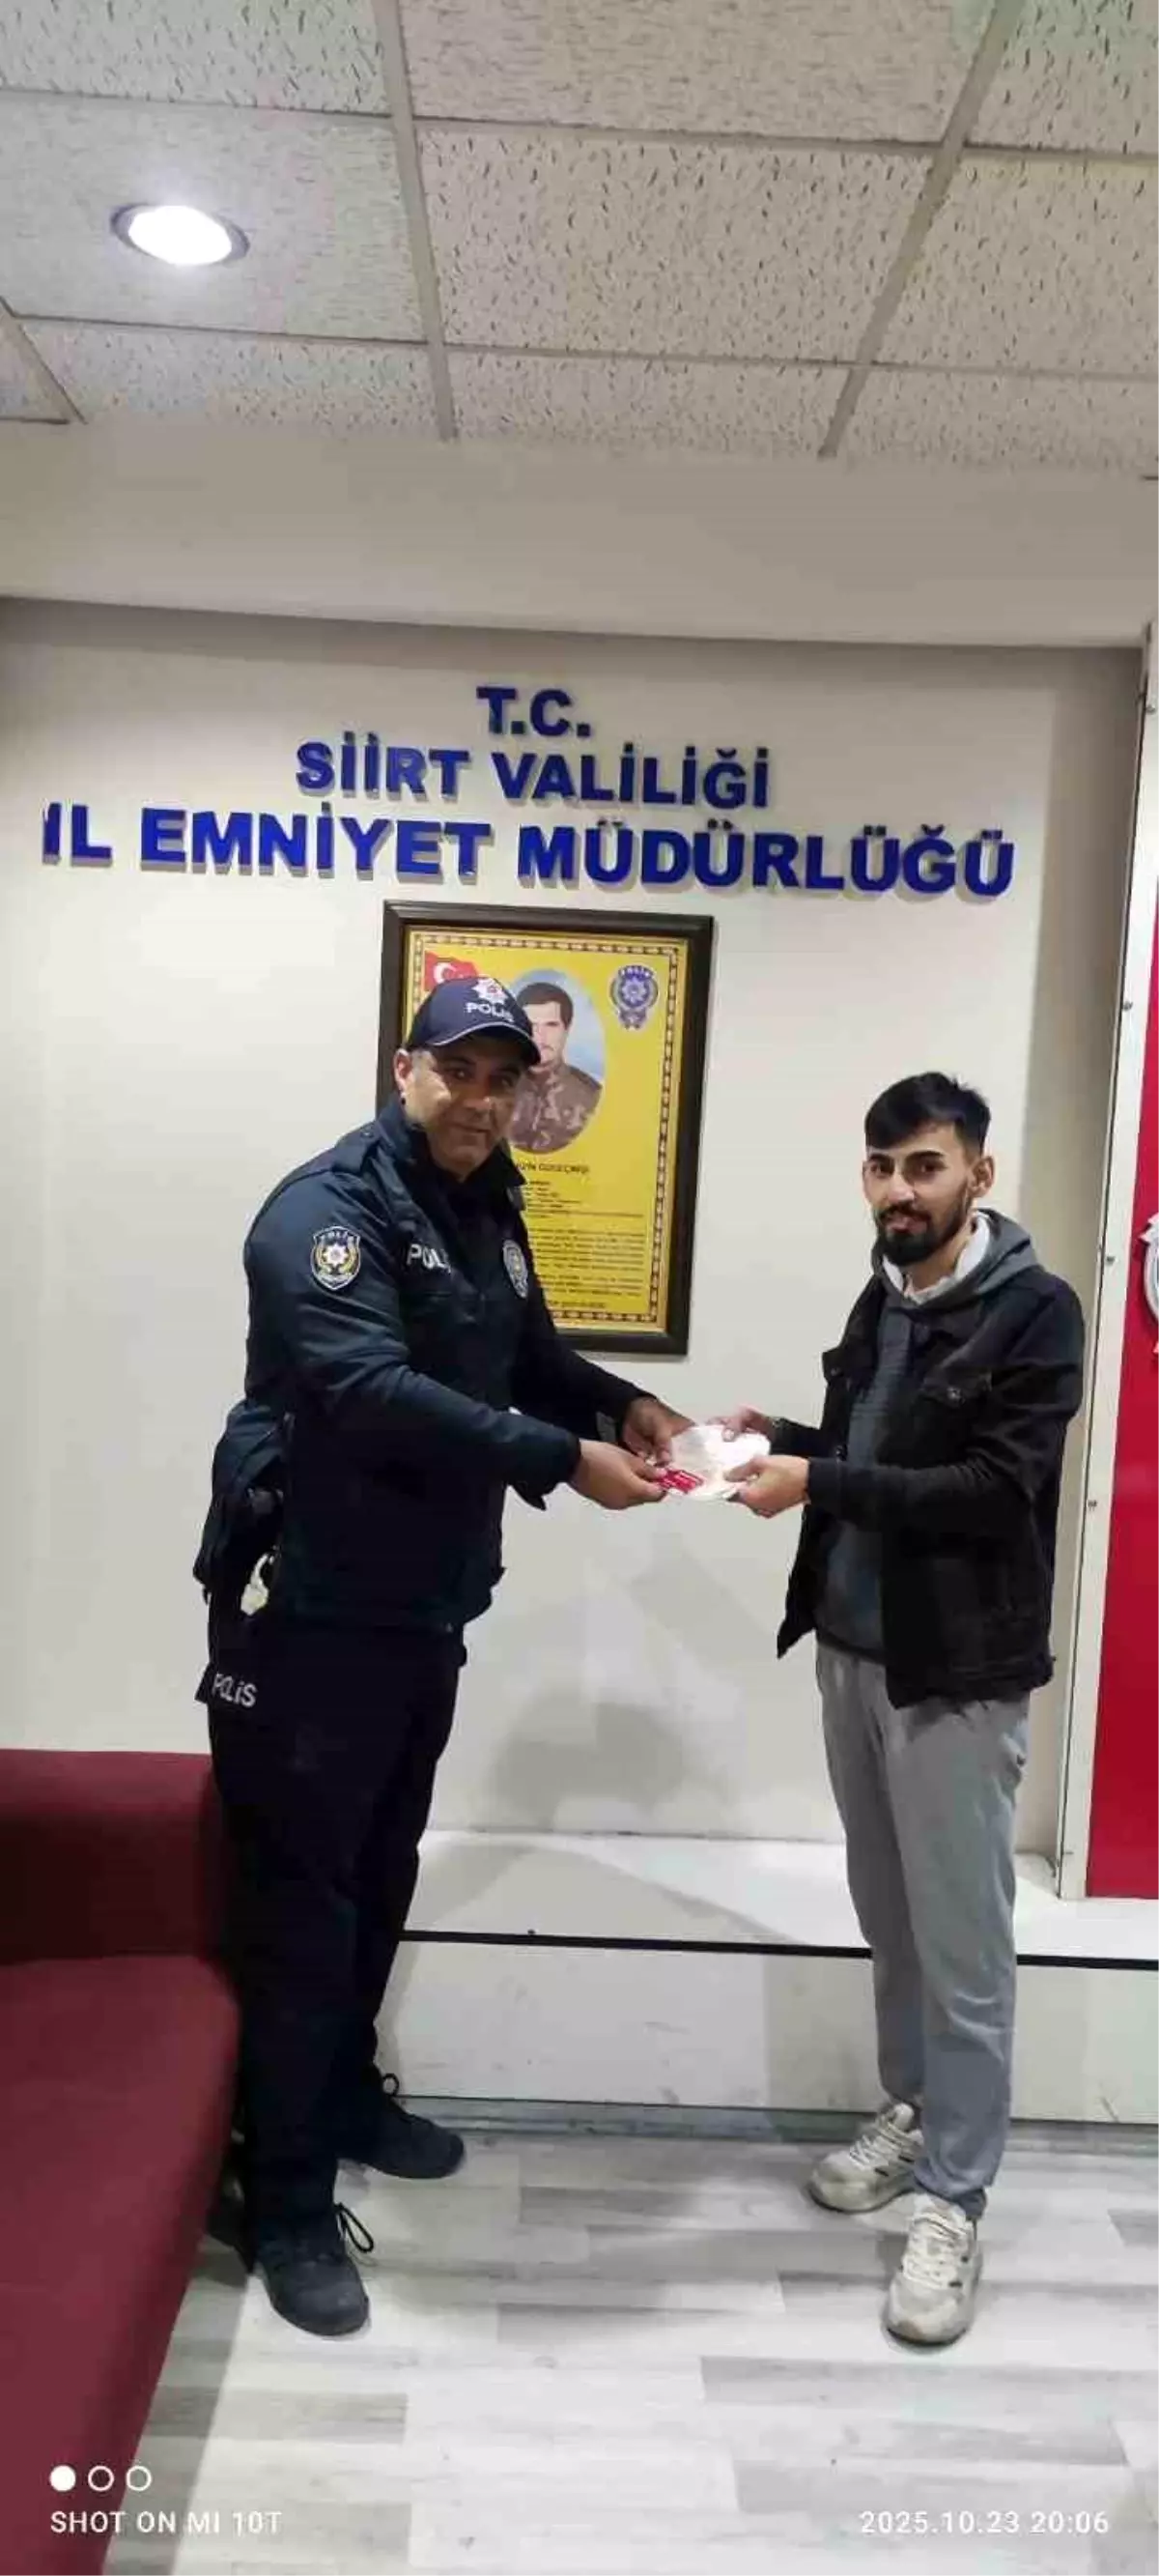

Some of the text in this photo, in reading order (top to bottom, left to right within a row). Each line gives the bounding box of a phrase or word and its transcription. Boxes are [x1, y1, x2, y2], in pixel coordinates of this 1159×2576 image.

[476, 686, 591, 738] T.C.
[295, 730, 771, 810] SİİRT VALİLİĞİ
[140, 801, 494, 886] EMNİYET
[517, 817, 1015, 899] MÜDÜRLÜĞÜ
